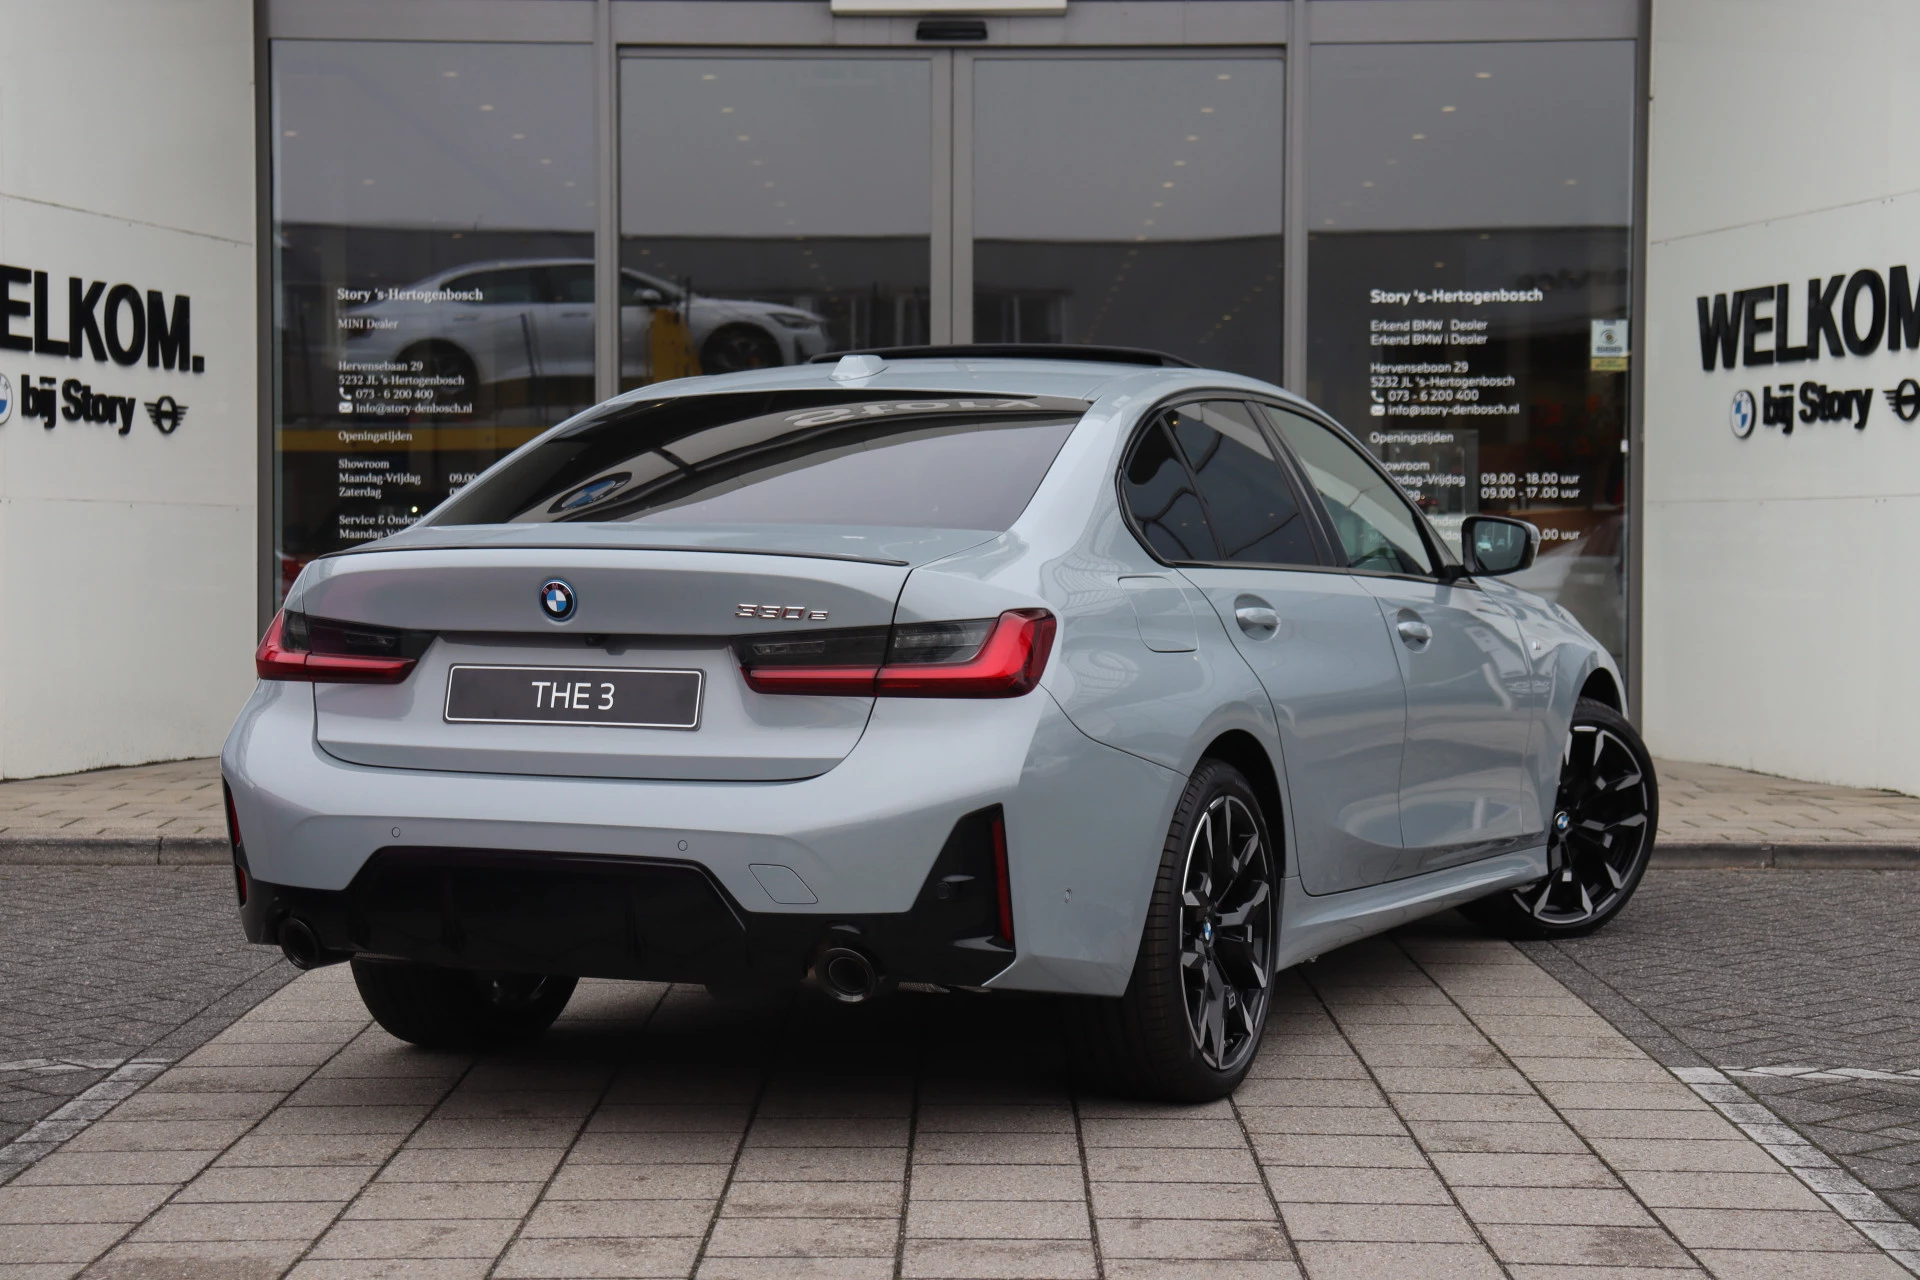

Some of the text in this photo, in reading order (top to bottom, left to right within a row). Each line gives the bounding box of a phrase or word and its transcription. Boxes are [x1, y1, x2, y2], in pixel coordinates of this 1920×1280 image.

[337, 288, 371, 303] Story
[1370, 289, 1411, 305] Story
[0, 264, 205, 373] ELKOM.
[338, 318, 398, 330] MINI Dealer
[1697, 265, 1920, 372] WELKOM
[1370, 319, 1488, 332] Erkend BMW Dealer
[1370, 334, 1410, 346] Erkend
[1413, 334, 1443, 345] BMW
[1450, 333, 1488, 345] Dealer
[338, 361, 424, 372] Hervensebaan 29
[1370, 361, 1469, 374] Hervensebaan 29
[338, 375, 364, 386] 5232
[365, 375, 379, 386] JL
[1370, 376, 1399, 388] 5232
[1400, 376, 1413, 388] JL
[355, 389, 375, 399] 073
[384, 389, 391, 399] 6
[392, 389, 412, 399] 200
[414, 389, 434, 399] 400
[1388, 390, 1410, 401] 073
[1420, 390, 1427, 401] 6
[1429, 390, 1453, 401] 200
[1455, 390, 1479, 401] 400
[61, 378, 136, 436] Story
[356, 403, 473, 415] info@story-denbosch.nl
[1388, 403, 1520, 416] info@story-denbosch.nl
[1799, 381, 1874, 431] Story
[338, 430, 413, 444] Openingstijden
[1370, 432, 1454, 446] Openingstijden
[338, 458, 390, 470] Showroom
[1379, 461, 1430, 471] owroom
[339, 473, 422, 486] Maandag-Vrijdag
[1393, 473, 1466, 487] ndag-Vrijdag
[1480, 473, 1516, 485] 09.00
[1526, 473, 1559, 485] 18.00
[1560, 475, 1580, 485] uur
[338, 487, 382, 499] Zaterdag
[1480, 487, 1516, 499] 09.00
[1560, 488, 1580, 498] uur
[339, 514, 424, 525] Service & Onder
[1539, 528, 1580, 540] .00 uur
[735, 603, 830, 620] 330e
[532, 681, 616, 711] THE 3
